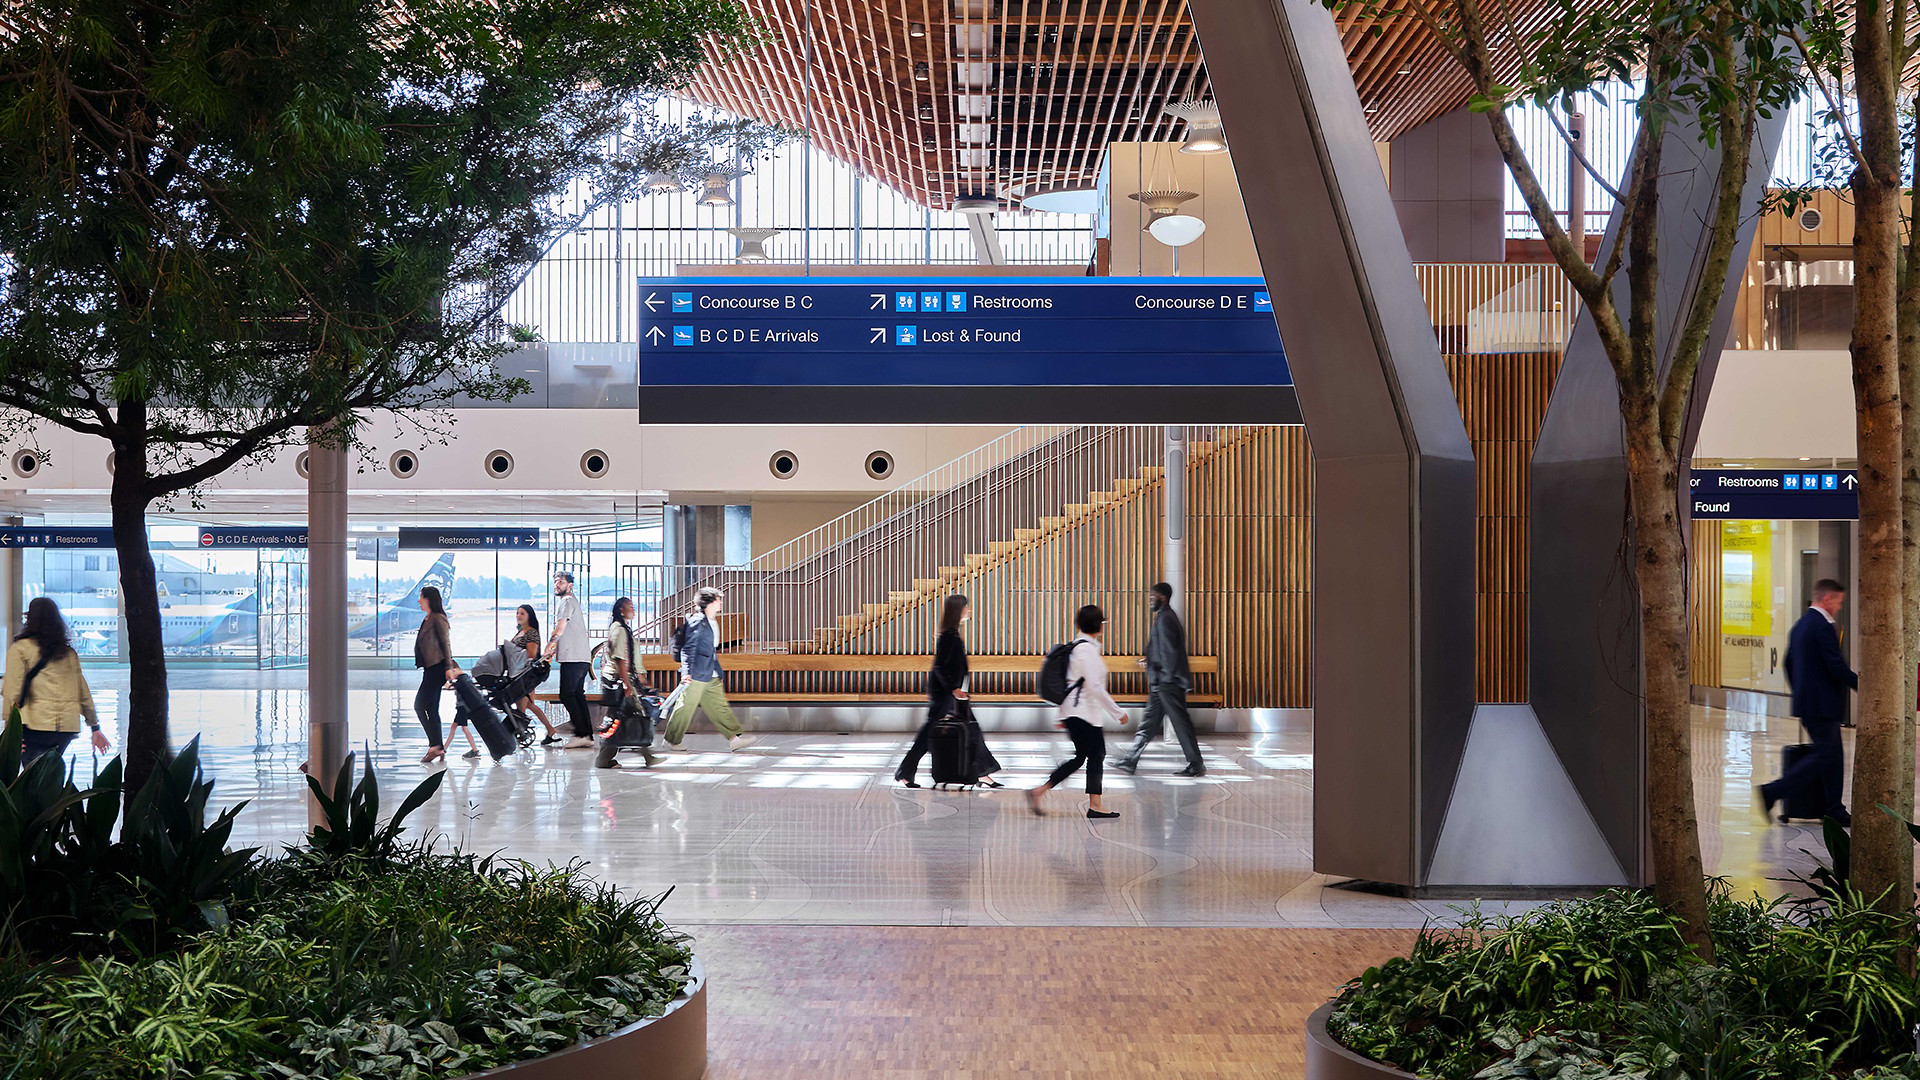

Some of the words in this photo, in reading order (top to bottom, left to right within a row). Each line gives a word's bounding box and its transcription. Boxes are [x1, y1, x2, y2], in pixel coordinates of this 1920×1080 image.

[699, 295, 780, 309] Concourse
[785, 295, 796, 309] B
[800, 295, 813, 309] C
[973, 295, 1053, 309] Restrooms
[1134, 295, 1216, 309] Concourse
[1221, 295, 1232, 309] D
[1237, 295, 1247, 309] E
[700, 329, 711, 343] B
[716, 329, 728, 343] C
[733, 329, 745, 342] D
[750, 329, 760, 342] E
[764, 329, 819, 343] Arrivals
[923, 329, 955, 343] Lost
[959, 329, 971, 343] &
[976, 328, 1021, 343] Found
[1718, 476, 1779, 488] Restrooms
[1695, 501, 1730, 512] Found
[55, 535, 98, 544] Restrooms
[217, 535, 224, 544] B
[225, 535, 233, 544] C
[233, 535, 241, 544] D
[242, 535, 249, 544] E
[249, 535, 280, 544] Arrivals
[284, 535, 297, 544] No
[438, 536, 481, 545] Restrooms
